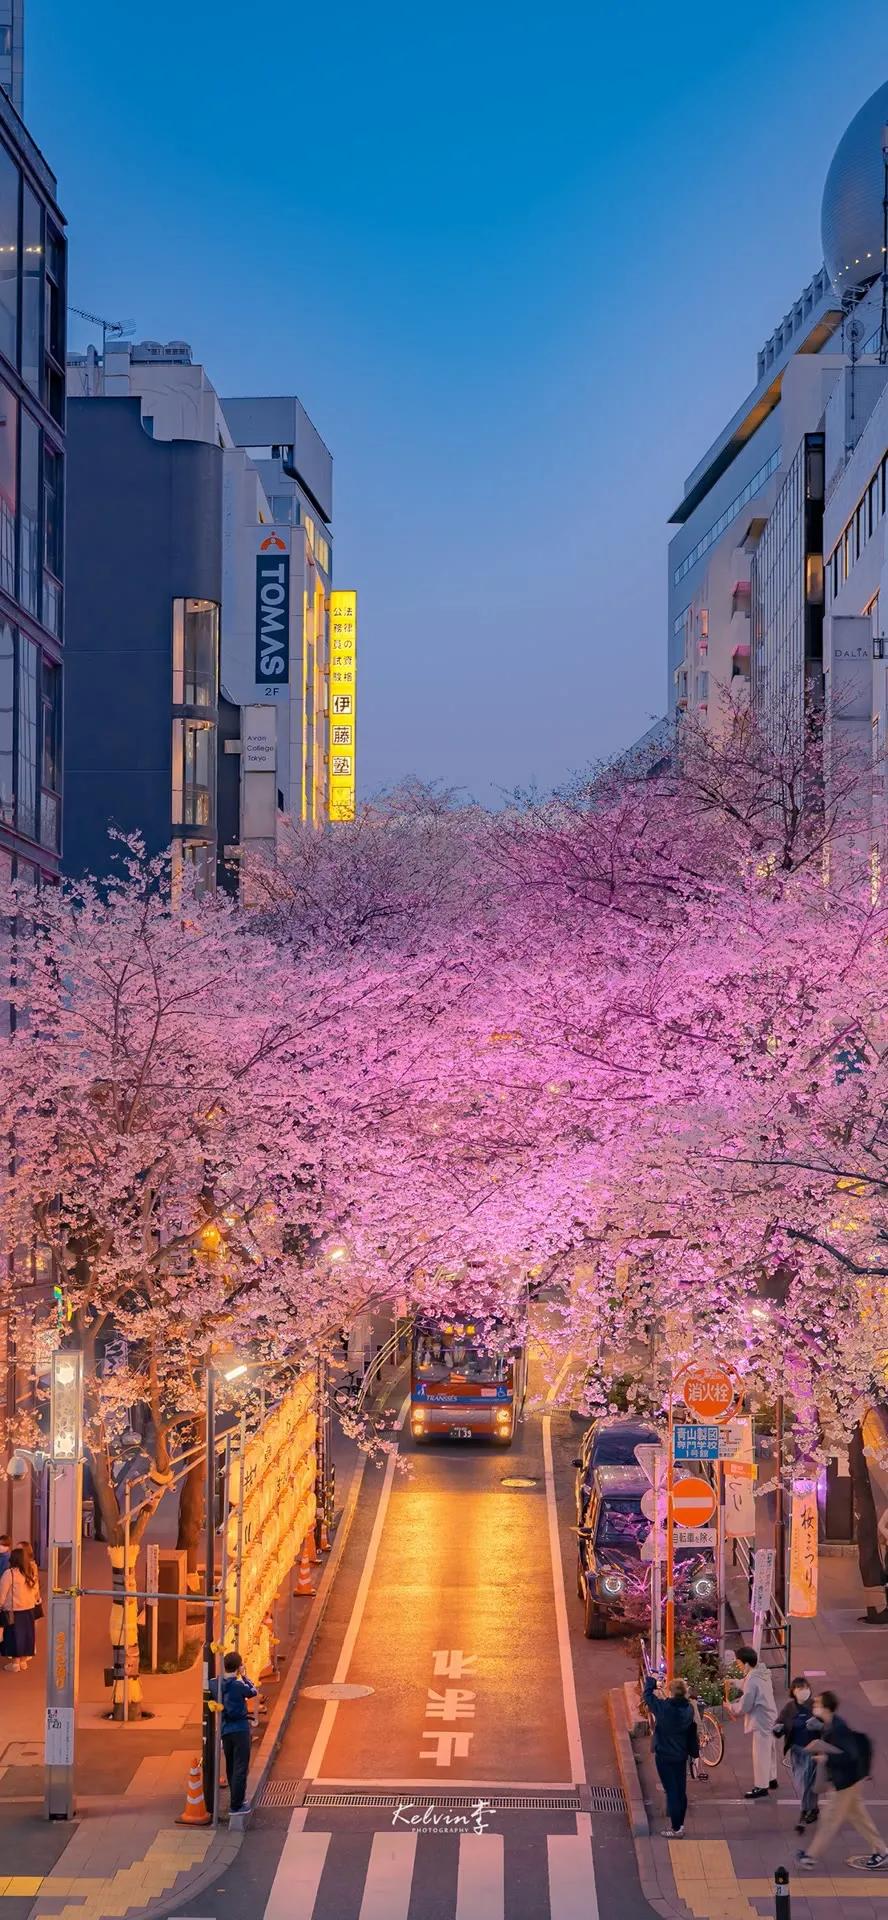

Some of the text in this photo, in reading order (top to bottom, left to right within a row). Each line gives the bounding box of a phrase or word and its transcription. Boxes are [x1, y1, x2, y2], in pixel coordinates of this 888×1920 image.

[260, 563, 285, 676] TOMAS
[264, 688, 279, 697] 2F
[333, 696, 351, 775] 伊藤塾
[247, 745, 274, 753] College
[247, 755, 267, 763] Tokyo
[688, 1383, 730, 1402] 消火栓
[676, 1427, 718, 1440] 青山製図
[676, 1441, 718, 1450] 専門学校
[673, 1532, 713, 1544] 自転車を除く
[419, 1650, 480, 1766] 止まれ
